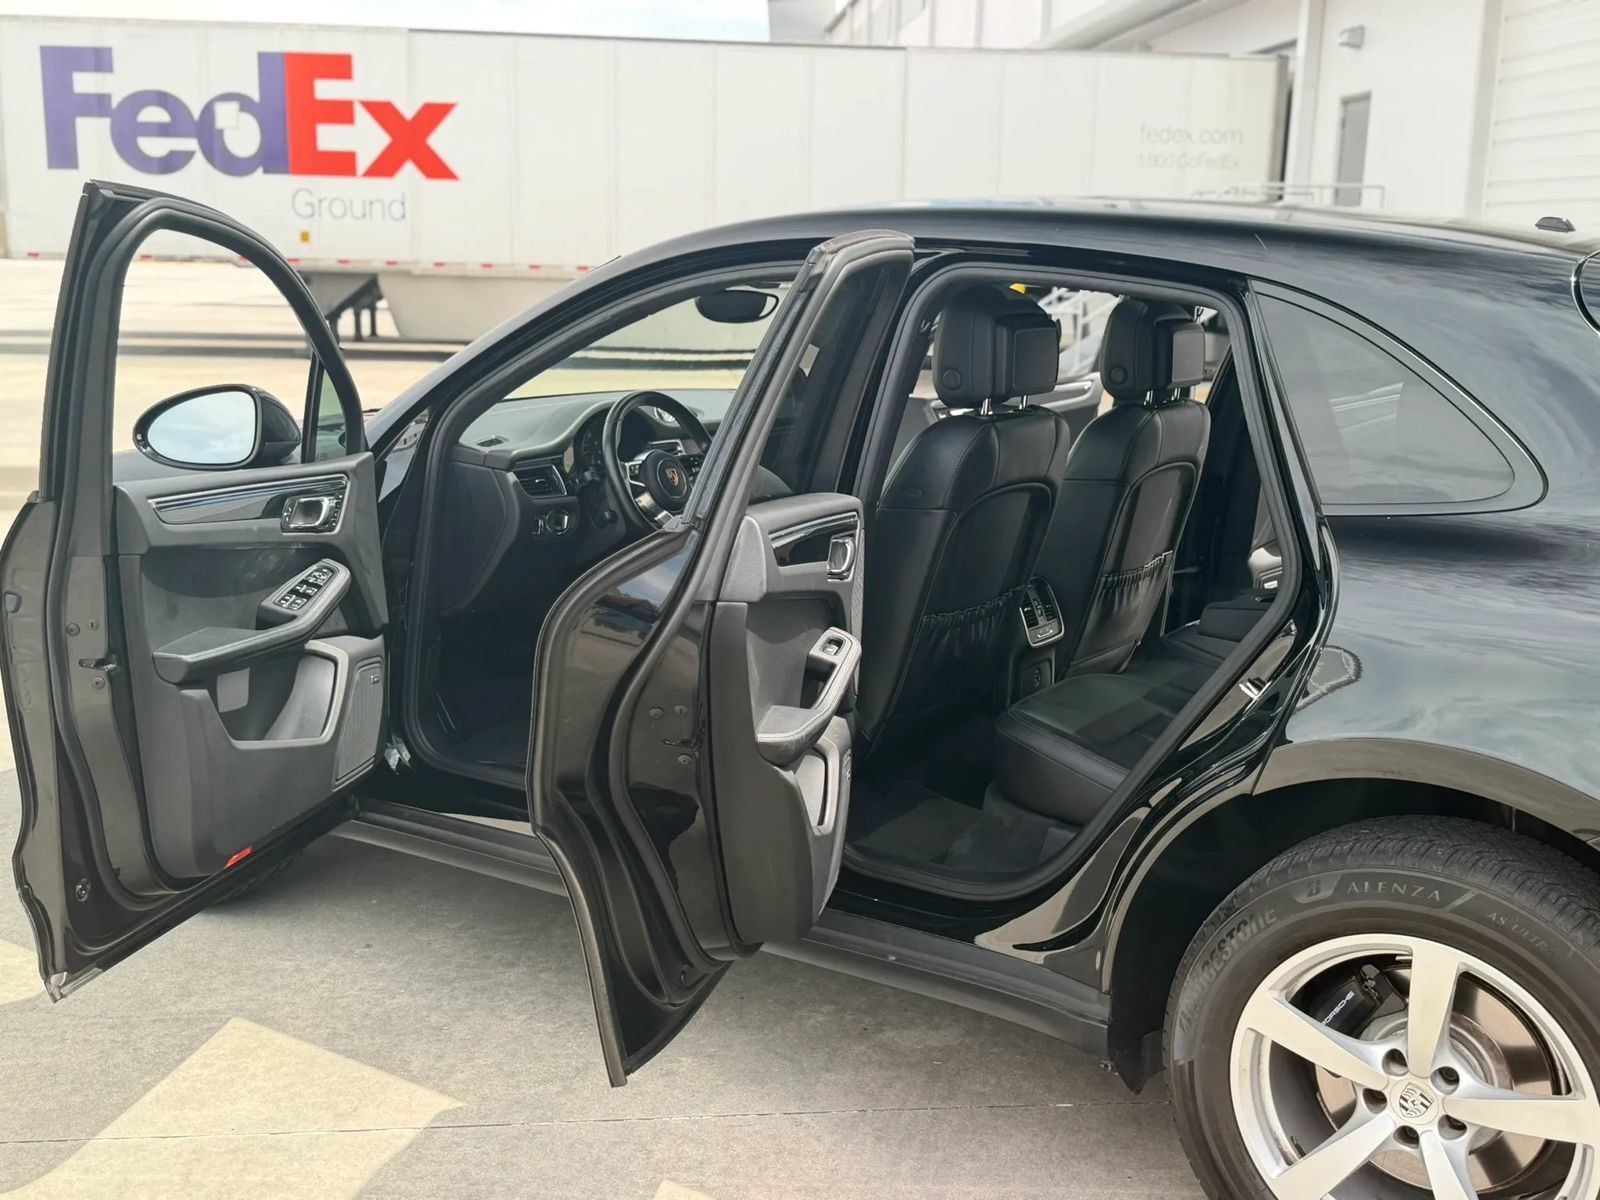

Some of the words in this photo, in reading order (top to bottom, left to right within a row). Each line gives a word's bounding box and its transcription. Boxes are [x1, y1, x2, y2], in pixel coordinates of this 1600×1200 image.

[39, 45, 460, 181] FedEx
[291, 188, 406, 222] Ground
[1347, 880, 1441, 902] ALENZA
[1178, 907, 1279, 1035] BDGESTONE
